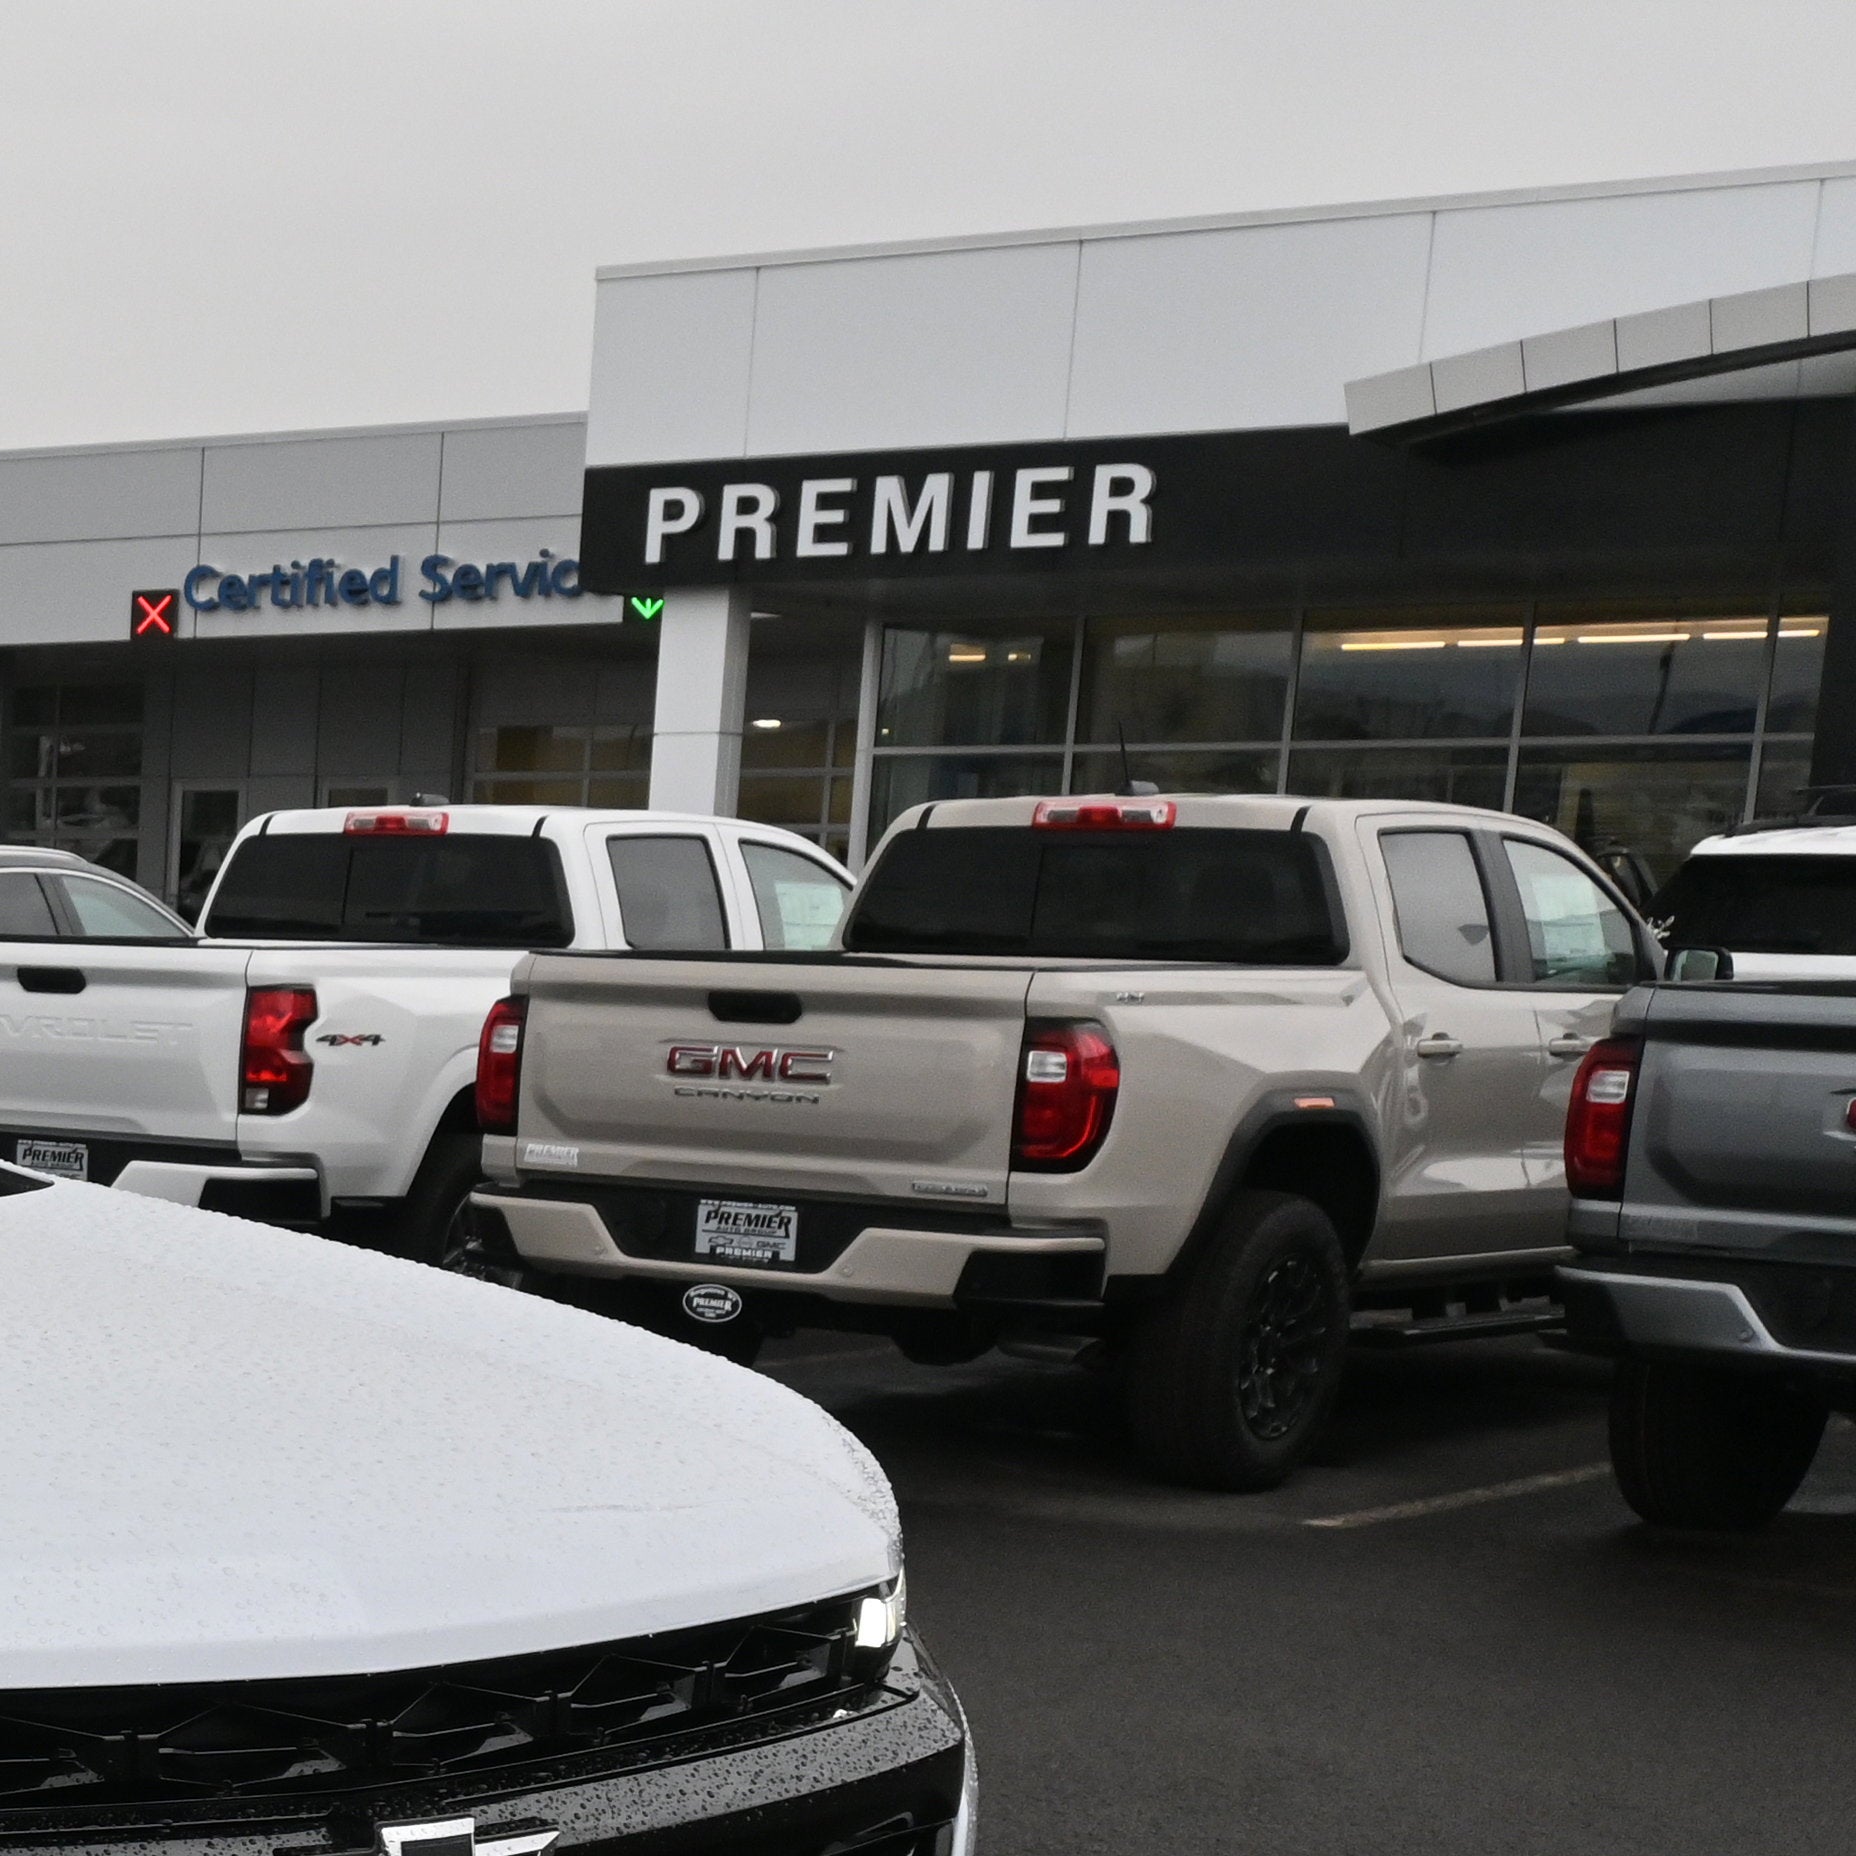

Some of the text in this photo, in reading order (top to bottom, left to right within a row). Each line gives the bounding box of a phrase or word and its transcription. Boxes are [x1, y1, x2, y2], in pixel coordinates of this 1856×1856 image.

[644, 462, 1158, 565] PREMIER
[184, 547, 582, 613] Certified Servic
[667, 1045, 834, 1085] GMC
[674, 1086, 820, 1105] CANYON
[22, 1145, 85, 1171] PREMIER
[704, 1203, 792, 1239] PREMIER
[715, 1246, 773, 1259] PREMIER
